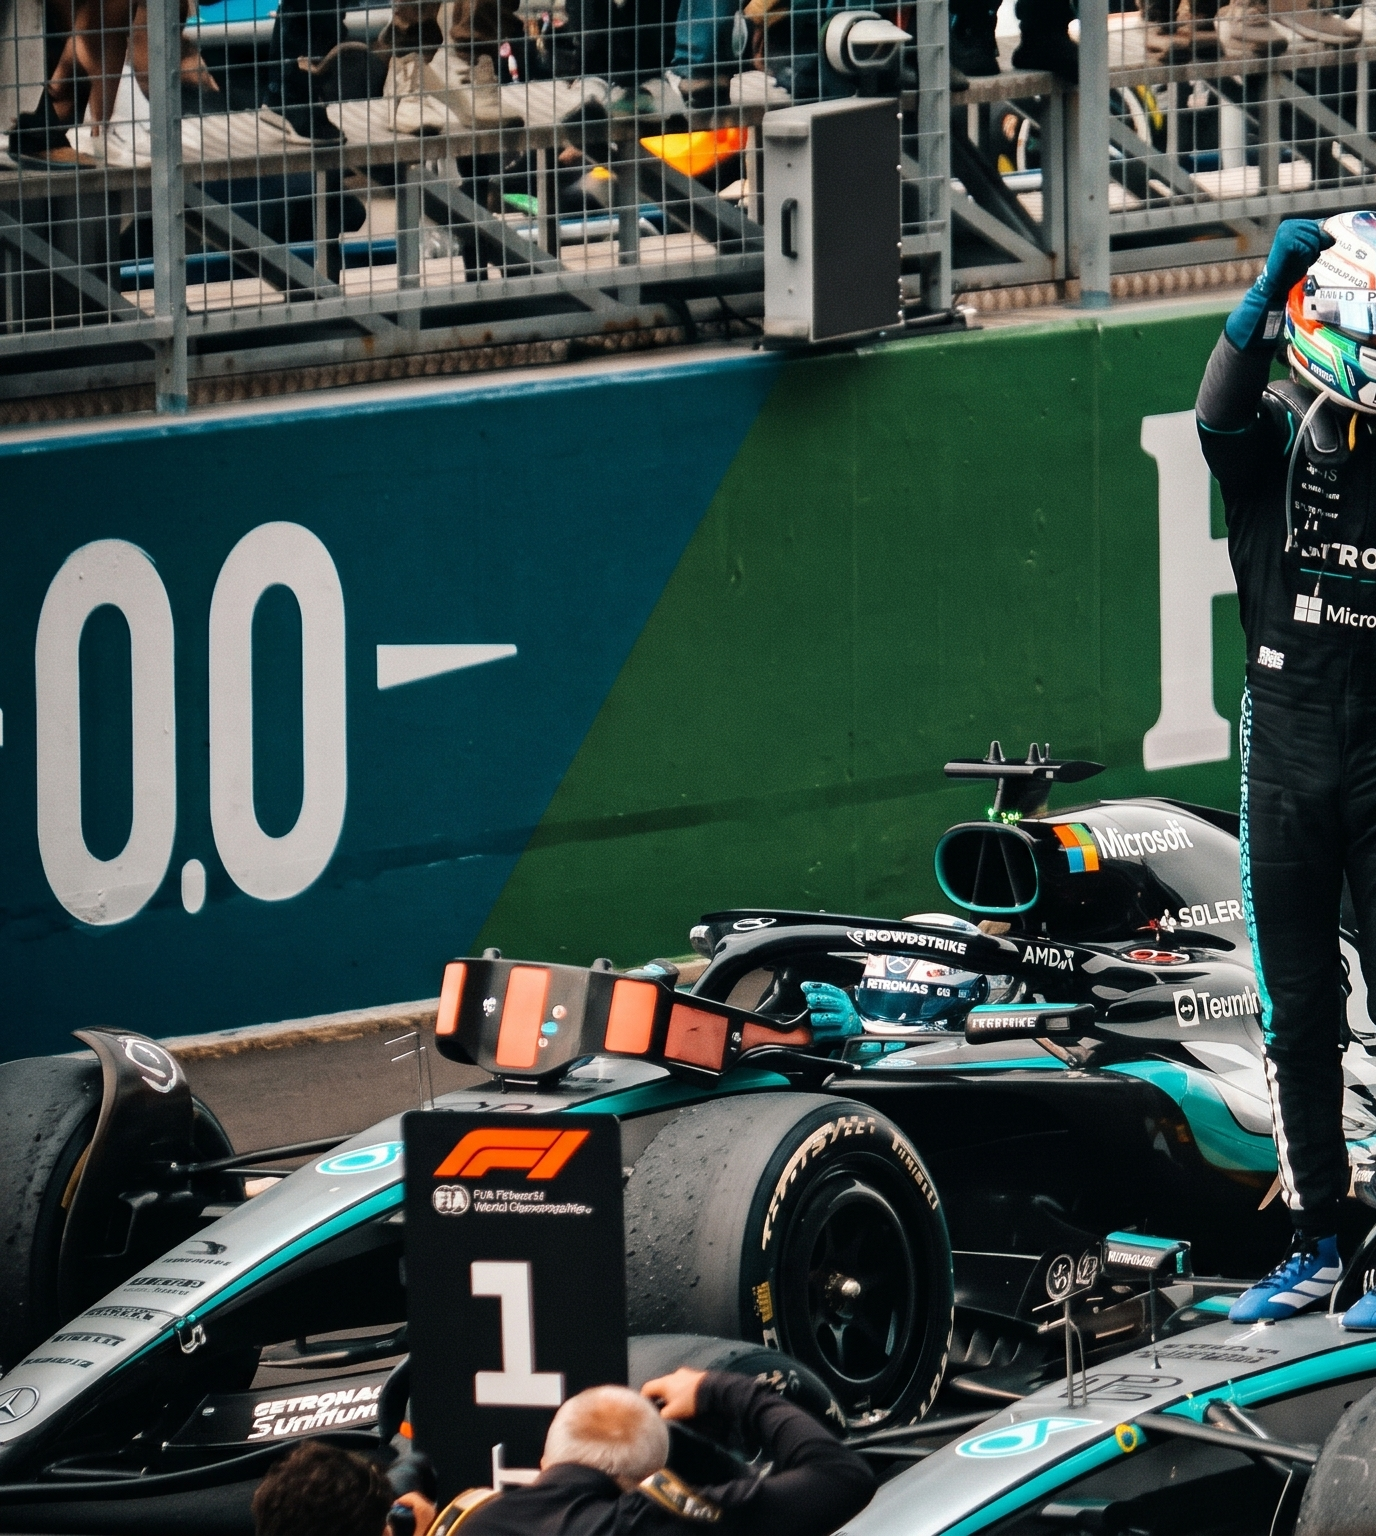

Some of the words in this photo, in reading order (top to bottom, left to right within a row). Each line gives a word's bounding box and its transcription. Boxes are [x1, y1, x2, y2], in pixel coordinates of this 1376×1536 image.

[35, 520, 348, 926] 0.0
[1178, 900, 1244, 928] SOLER
[433, 1129, 590, 1179] F1
[470, 1261, 566, 1407] 1
